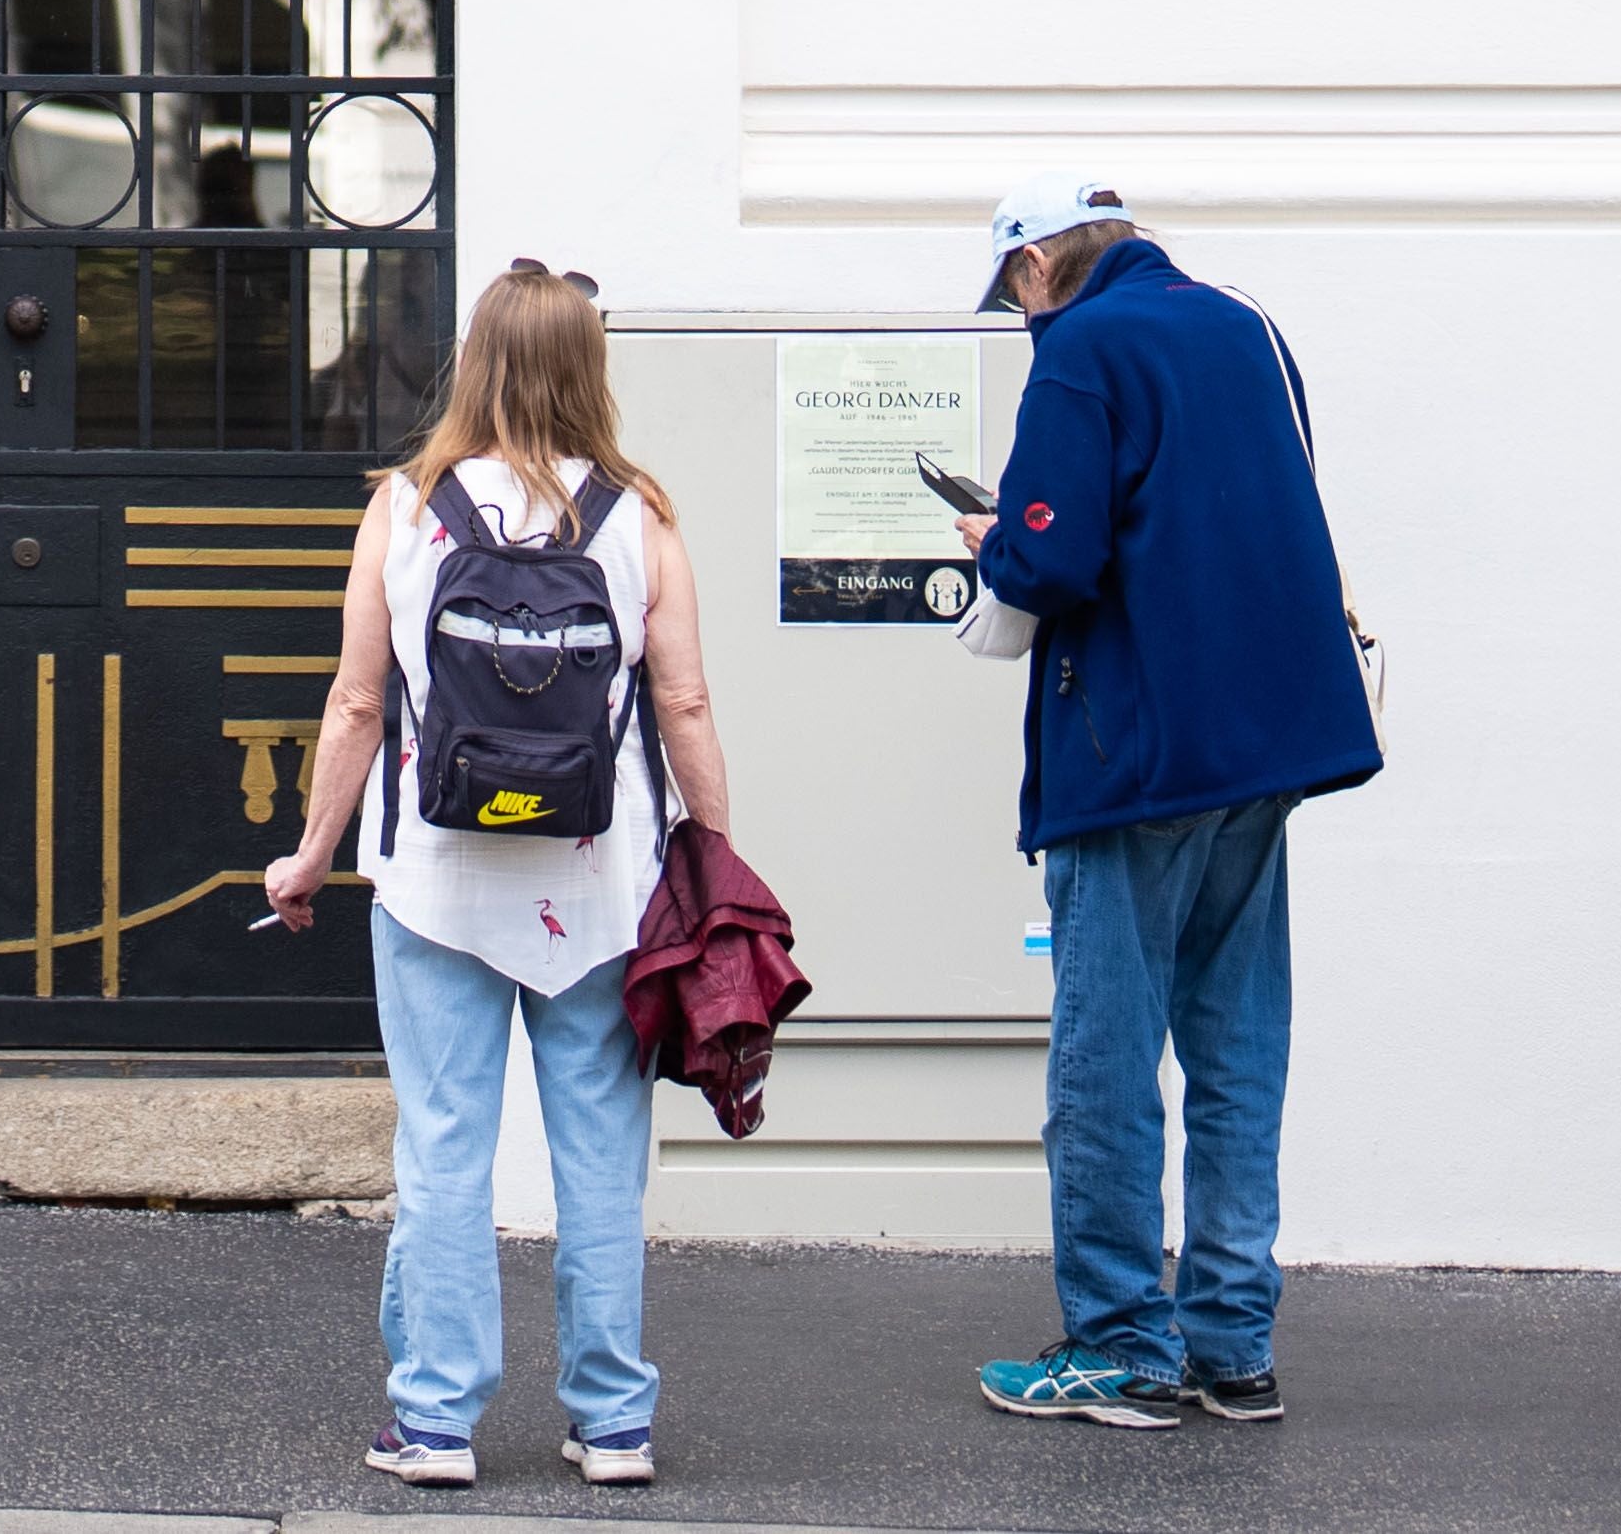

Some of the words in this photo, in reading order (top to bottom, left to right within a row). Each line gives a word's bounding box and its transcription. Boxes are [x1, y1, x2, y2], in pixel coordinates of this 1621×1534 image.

[795, 391, 872, 409] GEORG
[879, 391, 962, 409] DANZER
[837, 576, 915, 591] EINGANG
[490, 790, 543, 816] NIKE
